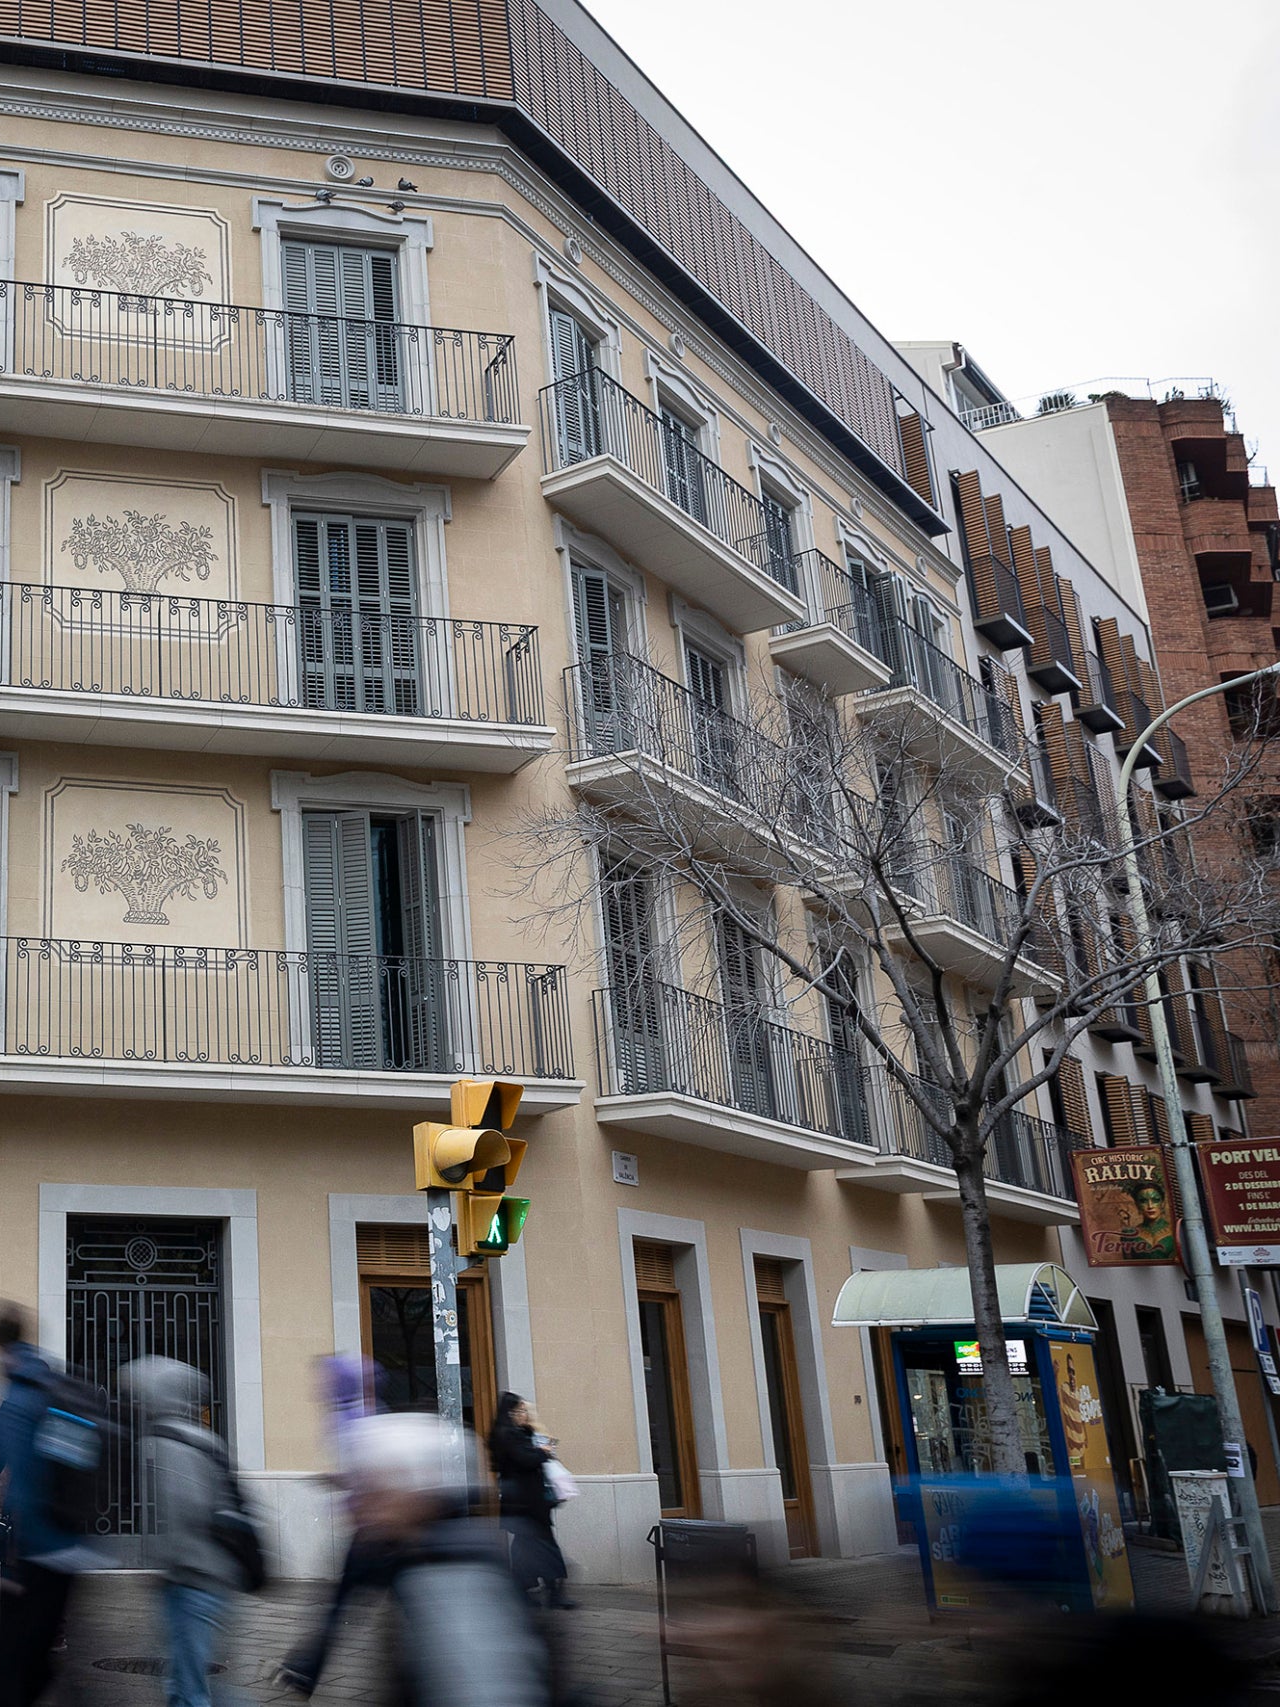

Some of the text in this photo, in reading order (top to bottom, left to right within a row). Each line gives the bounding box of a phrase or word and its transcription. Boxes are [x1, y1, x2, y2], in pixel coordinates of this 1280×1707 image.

[1091, 1155, 1108, 1165] CIRC
[1210, 1150, 1251, 1165] PORT
[1084, 1164, 1156, 1184] RALUY
[1238, 1170, 1269, 1179] DES DEL
[1224, 1183, 1232, 1191] 2
[1232, 1182, 1244, 1190] DE
[1247, 1191, 1264, 1200] FINS
[1238, 1203, 1245, 1211] 1
[1245, 1202, 1258, 1210] DE
[1091, 1228, 1165, 1254] Terra
